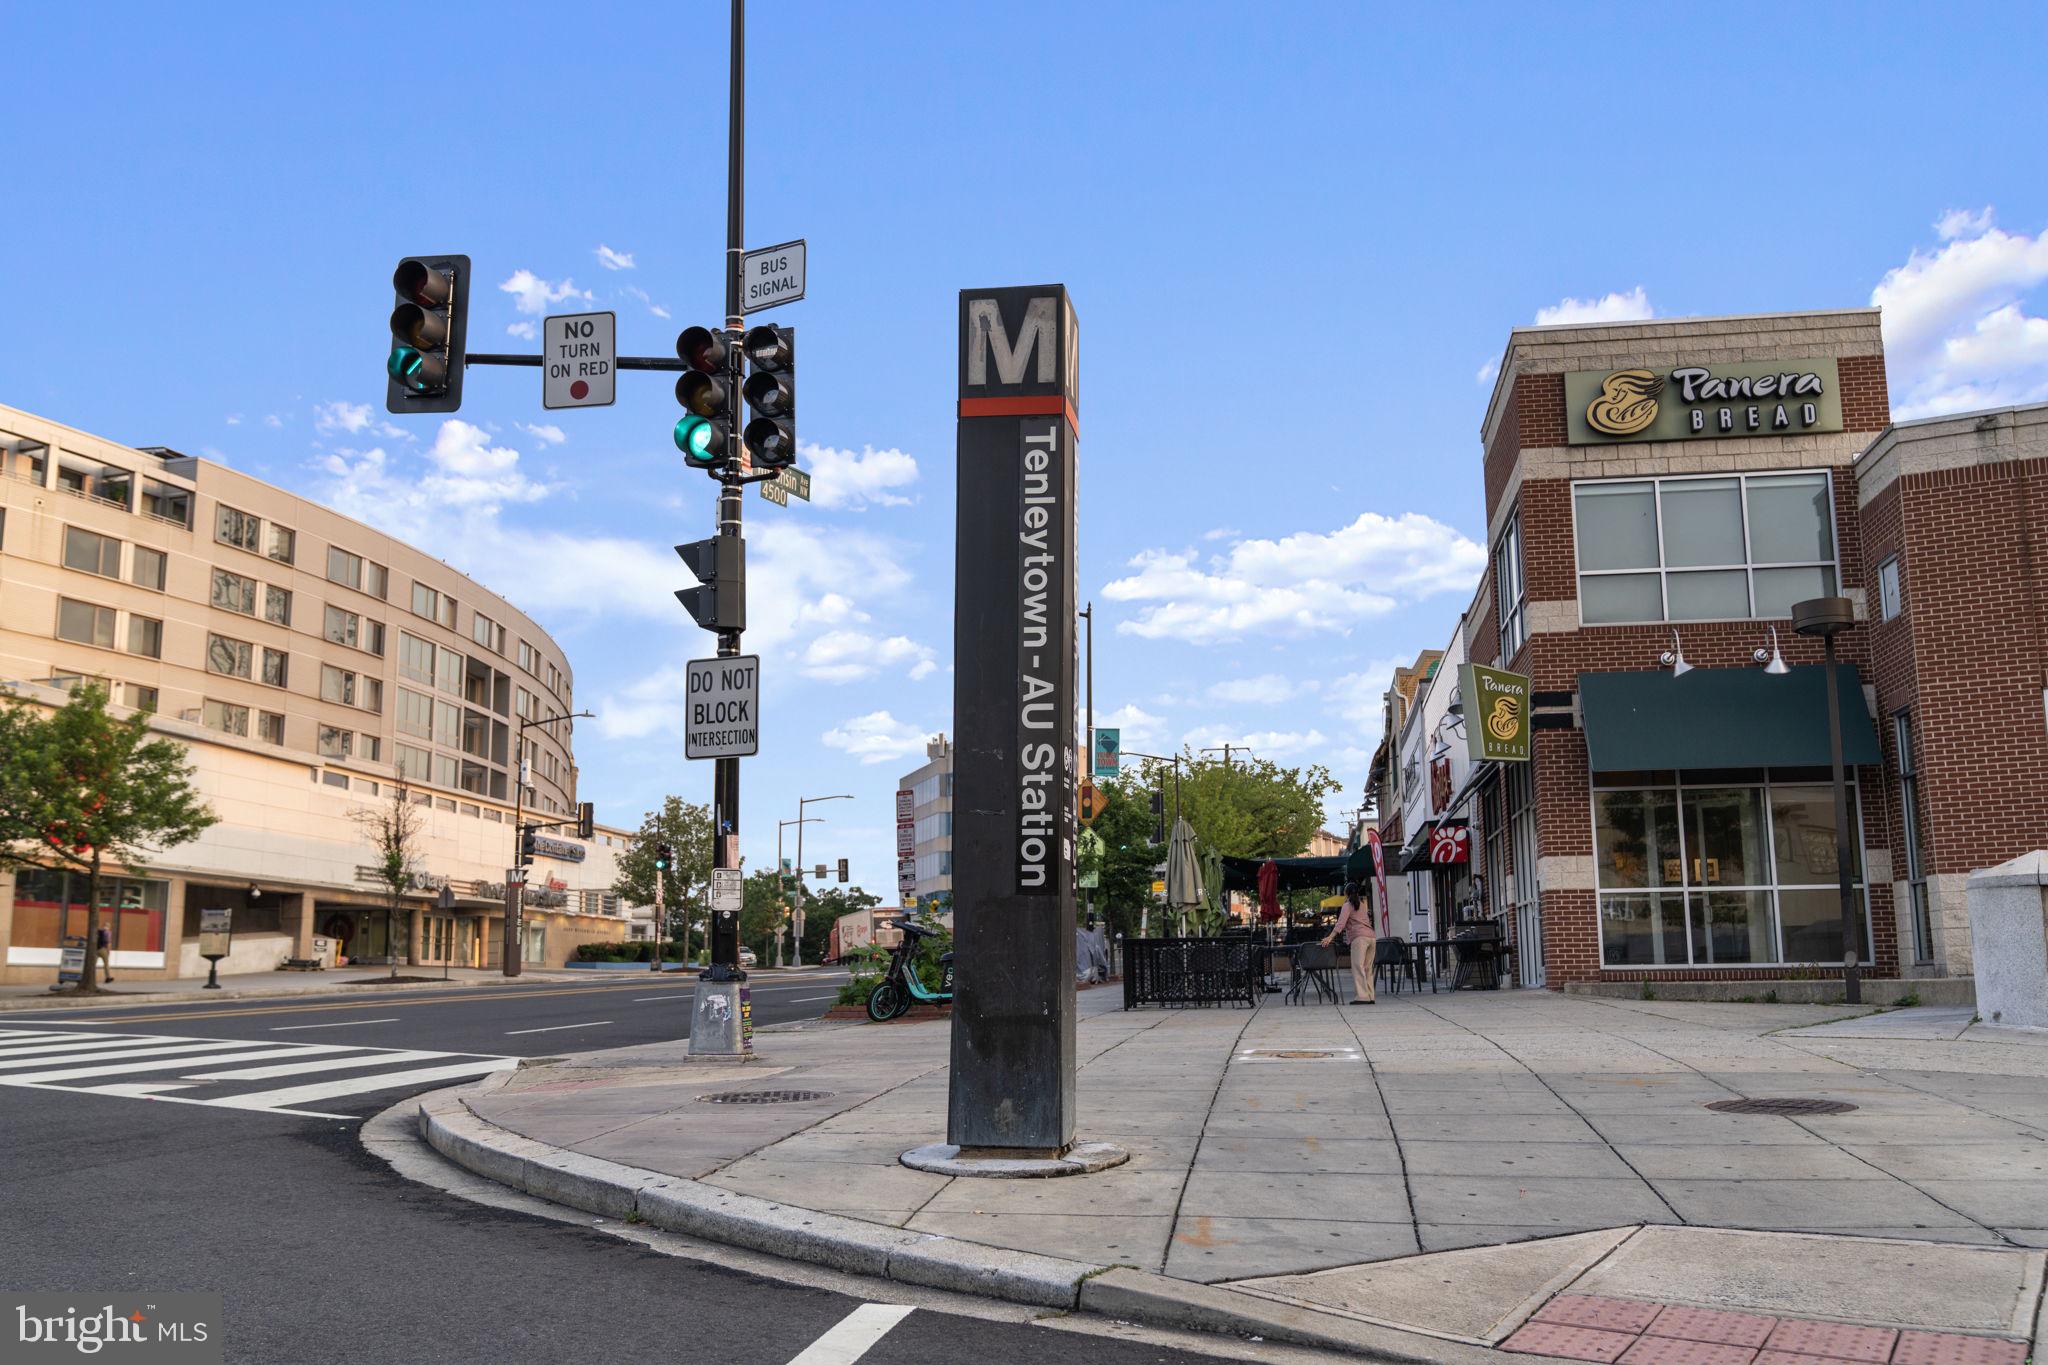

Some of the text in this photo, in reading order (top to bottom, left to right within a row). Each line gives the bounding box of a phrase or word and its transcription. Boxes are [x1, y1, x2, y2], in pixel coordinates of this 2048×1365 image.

[761, 257, 787, 275] BUS
[750, 275, 798, 299] SIGNAL
[565, 320, 594, 340] NO
[968, 297, 1057, 386] M
[559, 342, 600, 359] TURN
[550, 360, 609, 379] ON RED
[1671, 367, 1823, 403] Panera
[1690, 403, 1817, 432] BREAD
[762, 482, 787, 505] 4500
[1021, 426, 1057, 648] Tenleytown
[691, 667, 754, 693] DO NOT
[1482, 675, 1524, 696] Panera
[694, 700, 749, 725] BLOCK
[1021, 674, 1055, 729] AU
[688, 729, 755, 747] INTERSECTION
[1488, 742, 1524, 755] BREAD
[1021, 742, 1056, 887] Station
[511, 870, 523, 882] M
